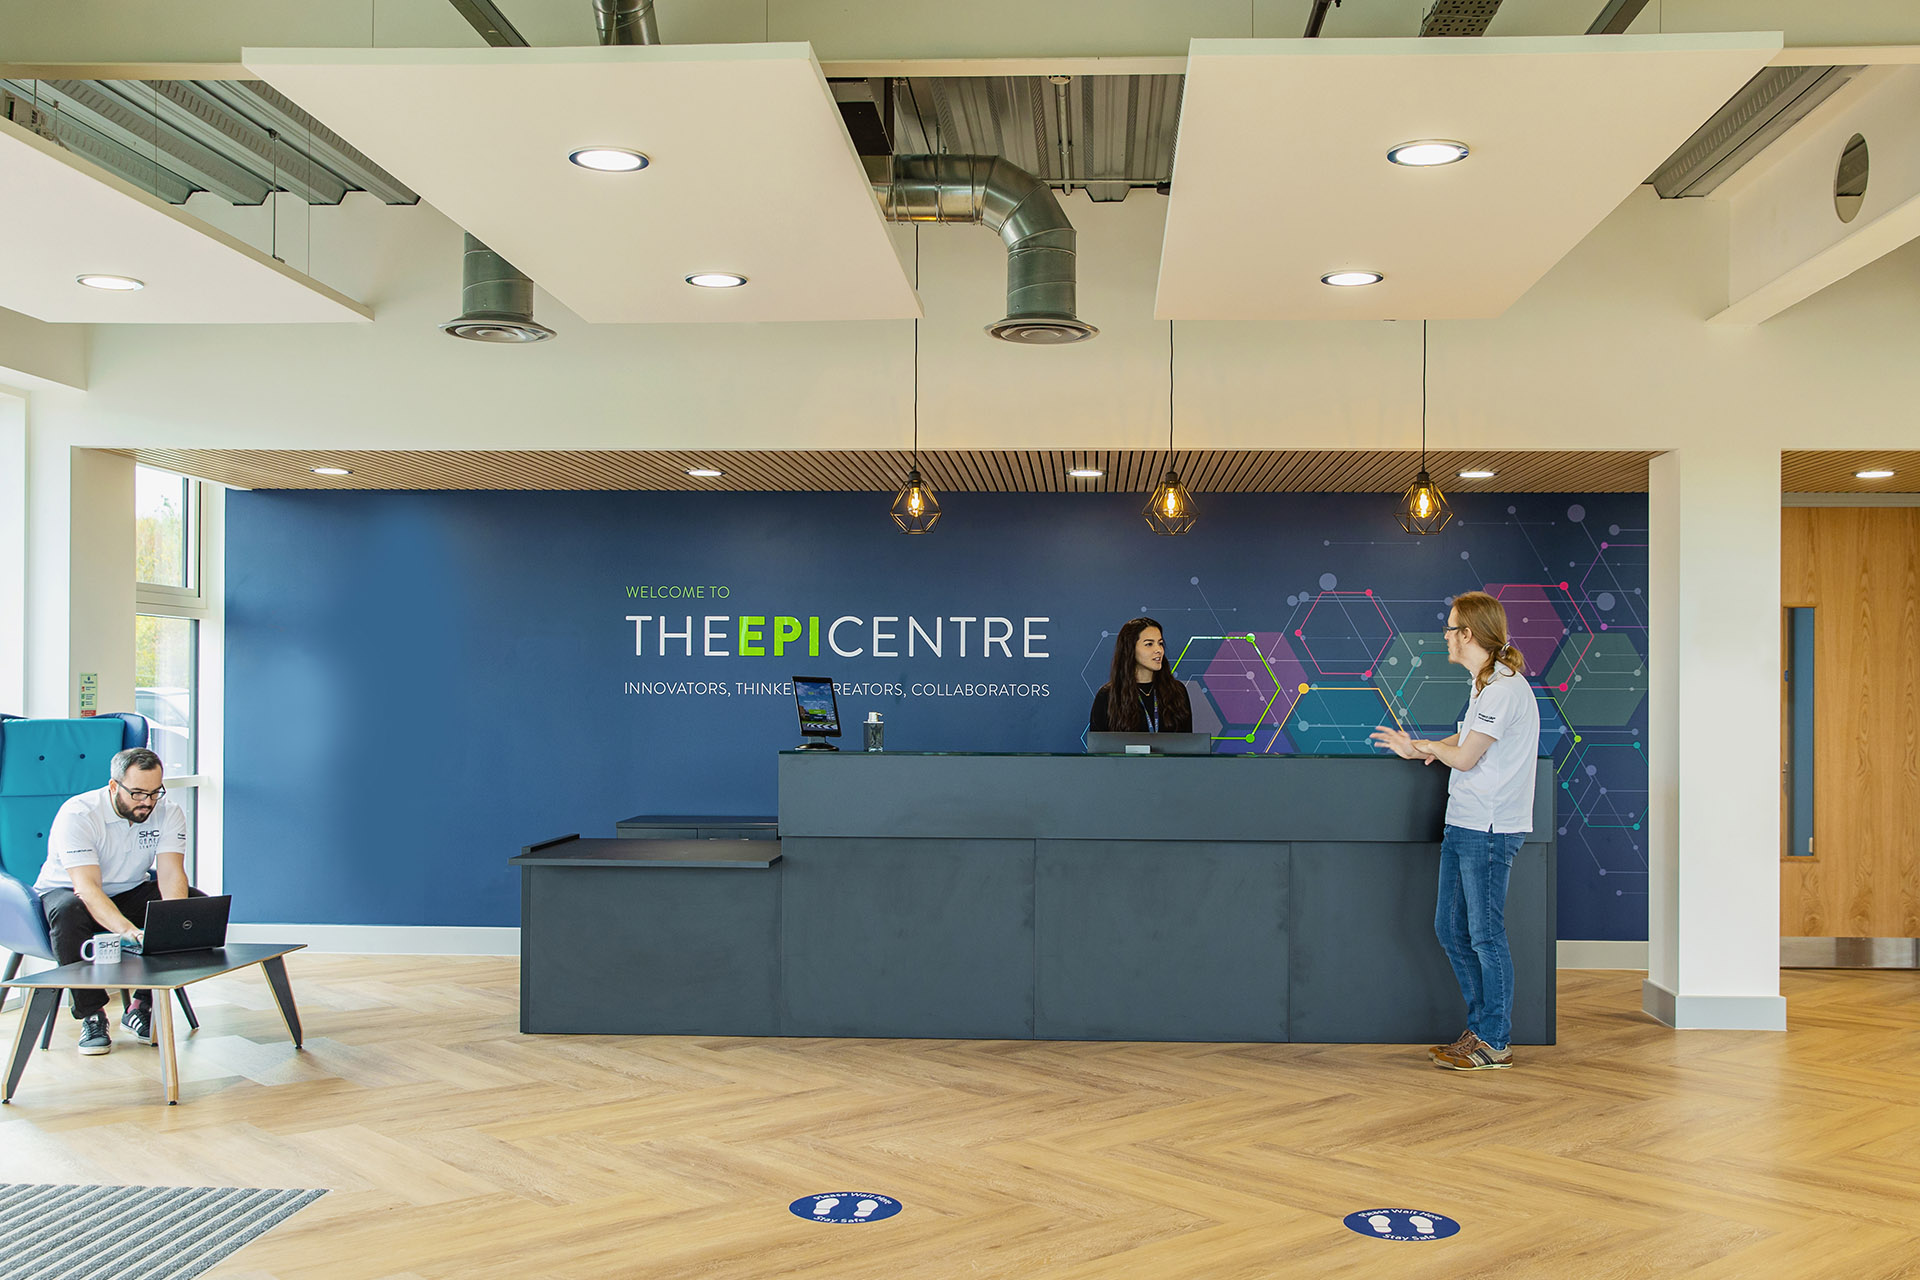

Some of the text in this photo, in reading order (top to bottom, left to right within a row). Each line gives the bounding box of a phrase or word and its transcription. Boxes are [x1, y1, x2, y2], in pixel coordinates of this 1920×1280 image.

[625, 585, 730, 599] WELCOME TO
[625, 615, 1050, 658] THEEPICENTRE
[624, 681, 1050, 698] INNOVATORS, THINKE REATORS, COLLABORATORS
[139, 830, 160, 838] SHC
[99, 941, 120, 949] SHC
[873, 1195, 892, 1205] Here
[1358, 1209, 1390, 1218] Please
[1419, 1211, 1443, 1221] Here
